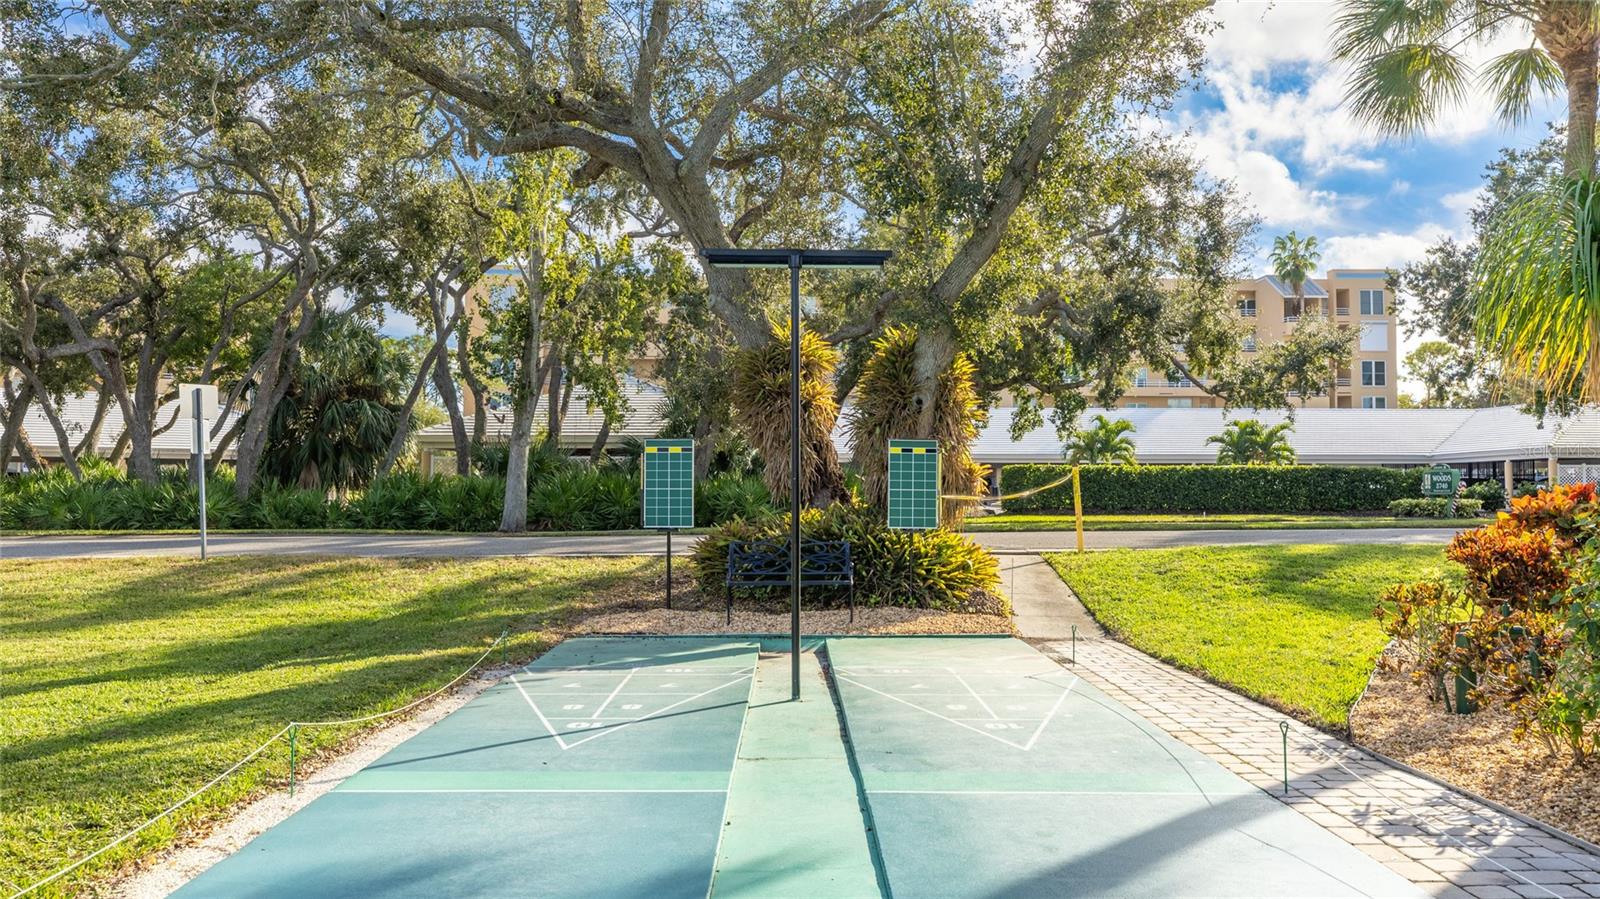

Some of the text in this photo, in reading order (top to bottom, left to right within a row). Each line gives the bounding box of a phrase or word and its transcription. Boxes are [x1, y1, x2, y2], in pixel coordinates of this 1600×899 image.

[1432, 474, 1452, 482] WOODS
[566, 721, 604, 729] 10
[983, 722, 1025, 730] 10
